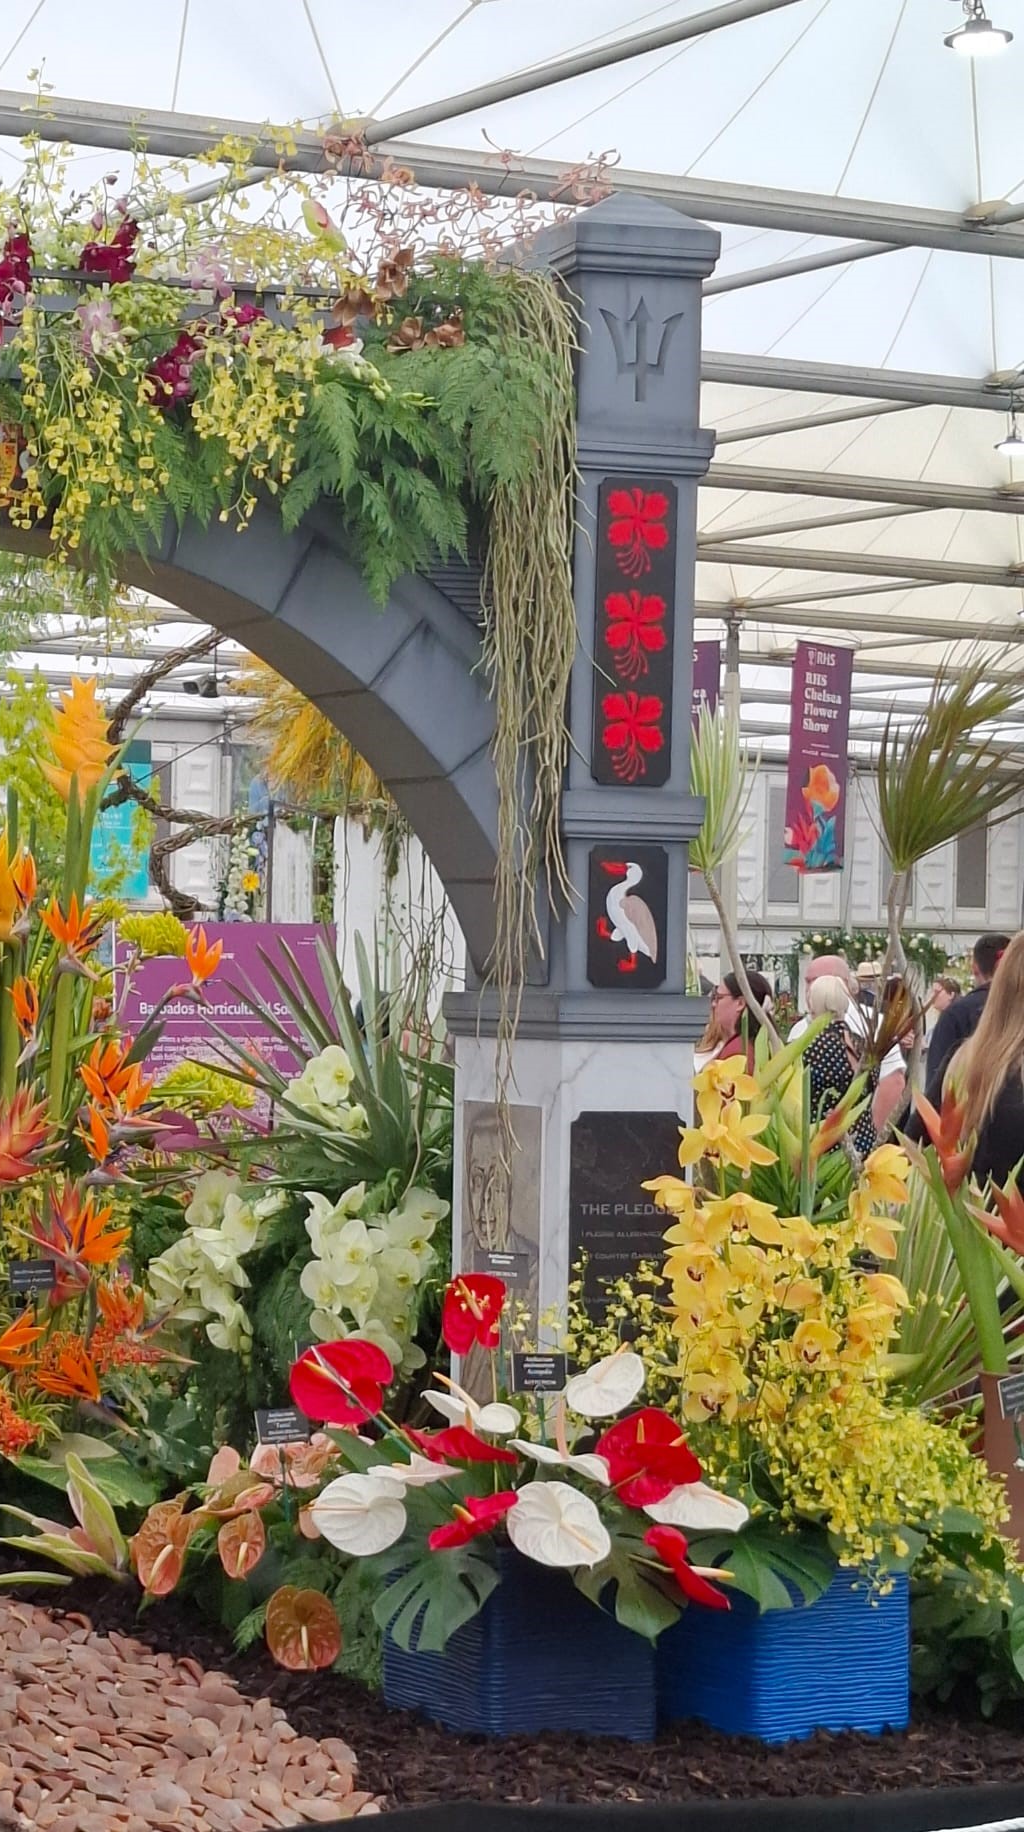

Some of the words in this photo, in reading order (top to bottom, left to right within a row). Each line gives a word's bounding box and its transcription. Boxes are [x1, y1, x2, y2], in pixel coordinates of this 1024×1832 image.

[817, 651, 836, 666] RHS
[805, 671, 828, 686] RHS
[804, 687, 842, 705] Chelsea
[804, 702, 838, 719] Flower
[803, 718, 829, 733] Show
[580, 1203, 611, 1215] THE
[614, 1203, 673, 1215] PLEDG
